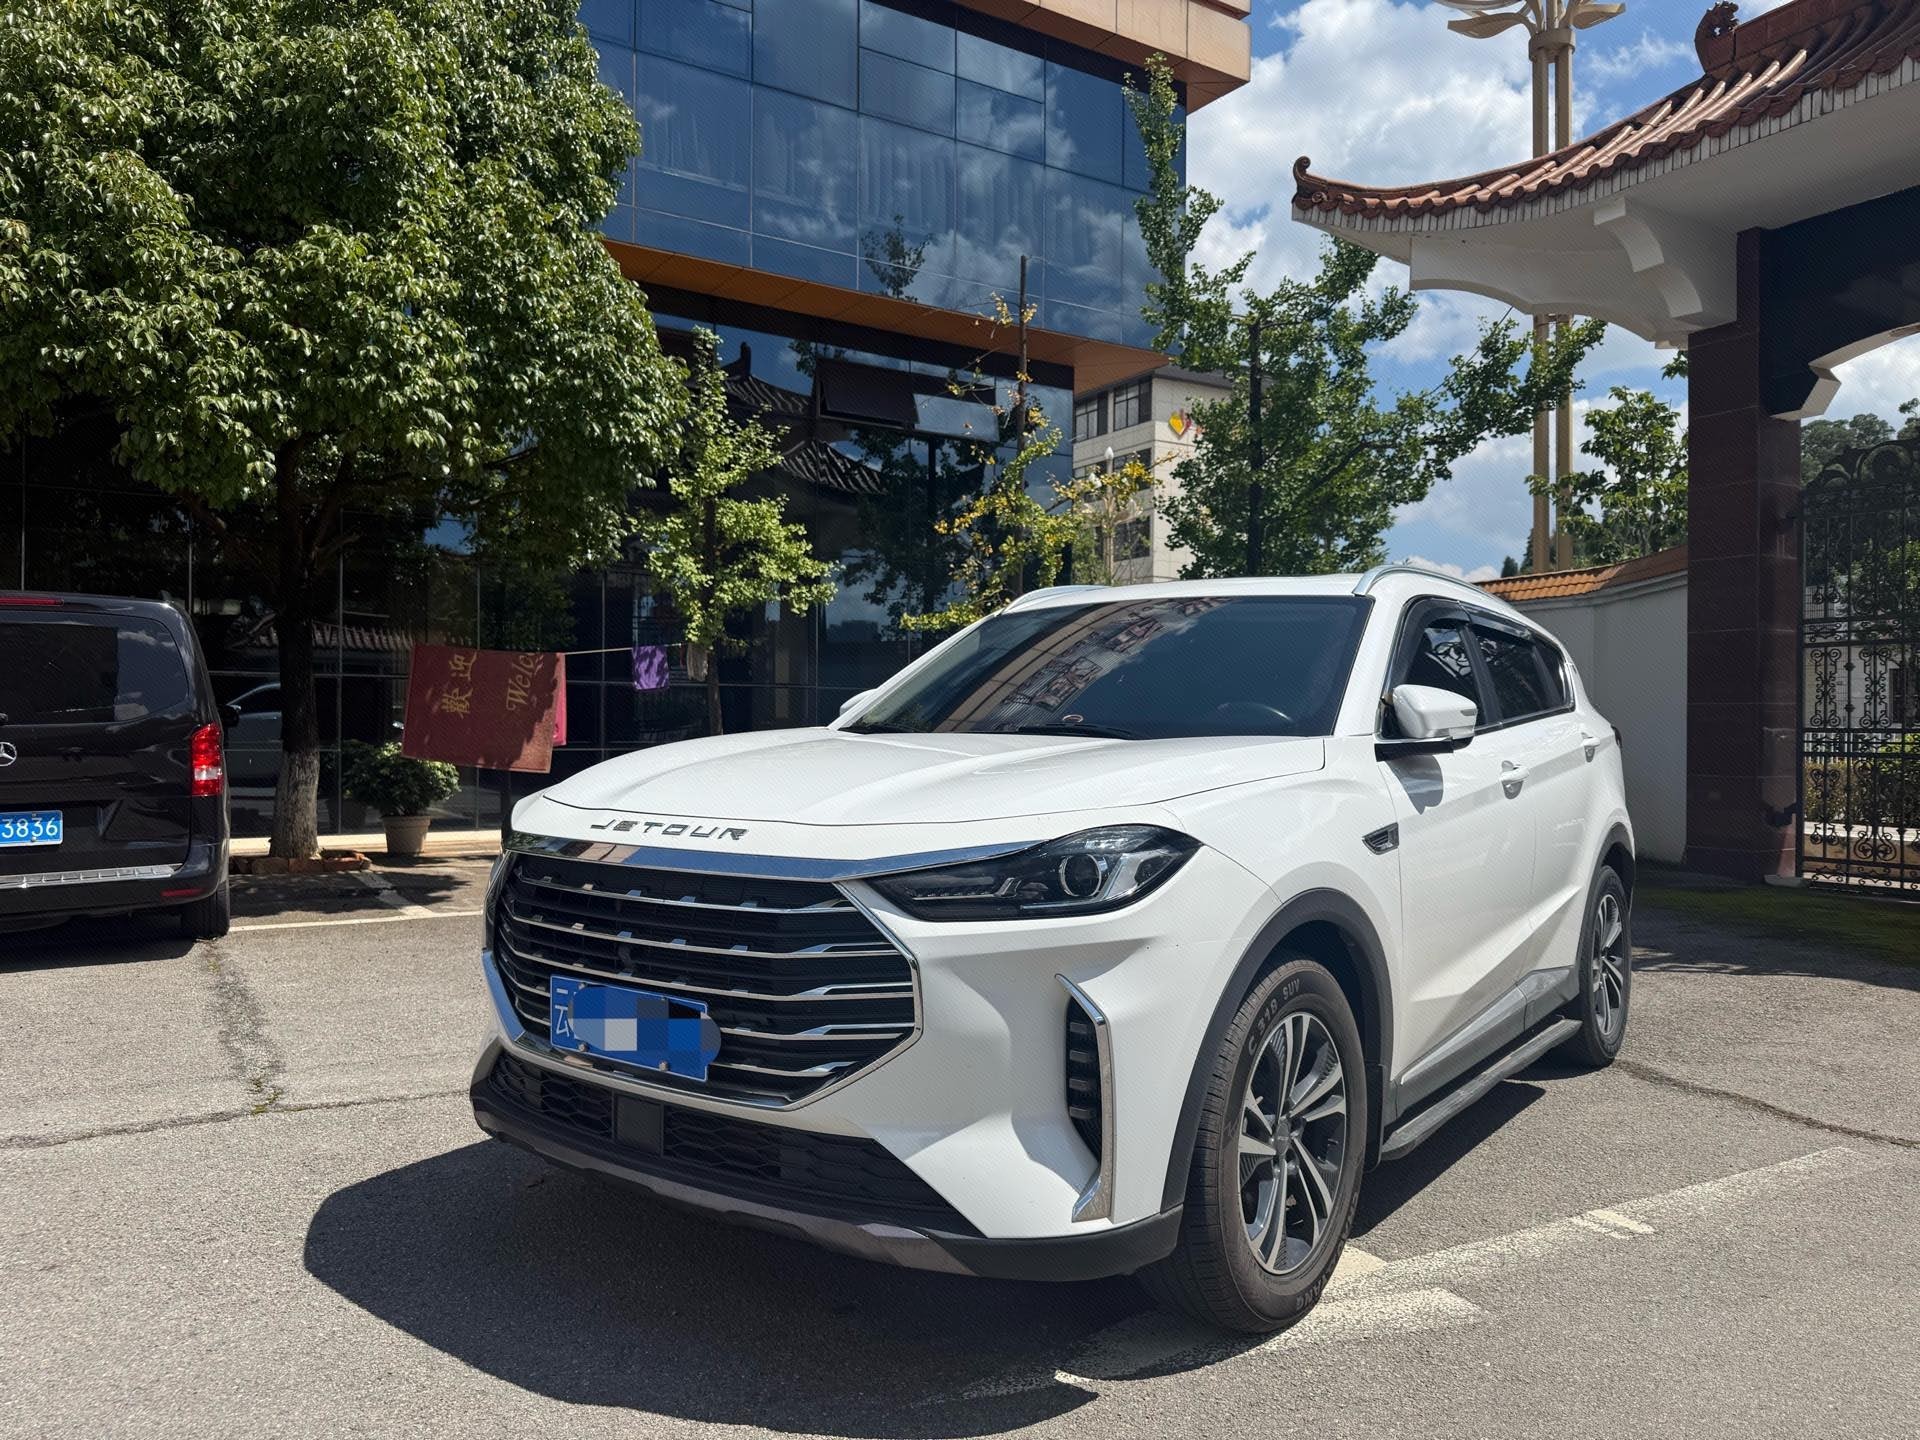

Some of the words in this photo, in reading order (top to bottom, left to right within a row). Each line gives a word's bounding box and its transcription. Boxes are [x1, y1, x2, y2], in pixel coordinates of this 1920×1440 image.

[441, 651, 479, 719] 歡迎
[2, 817, 58, 839] 3836
[590, 818, 748, 841] JETOUR
[1283, 978, 1300, 1001] SUV
